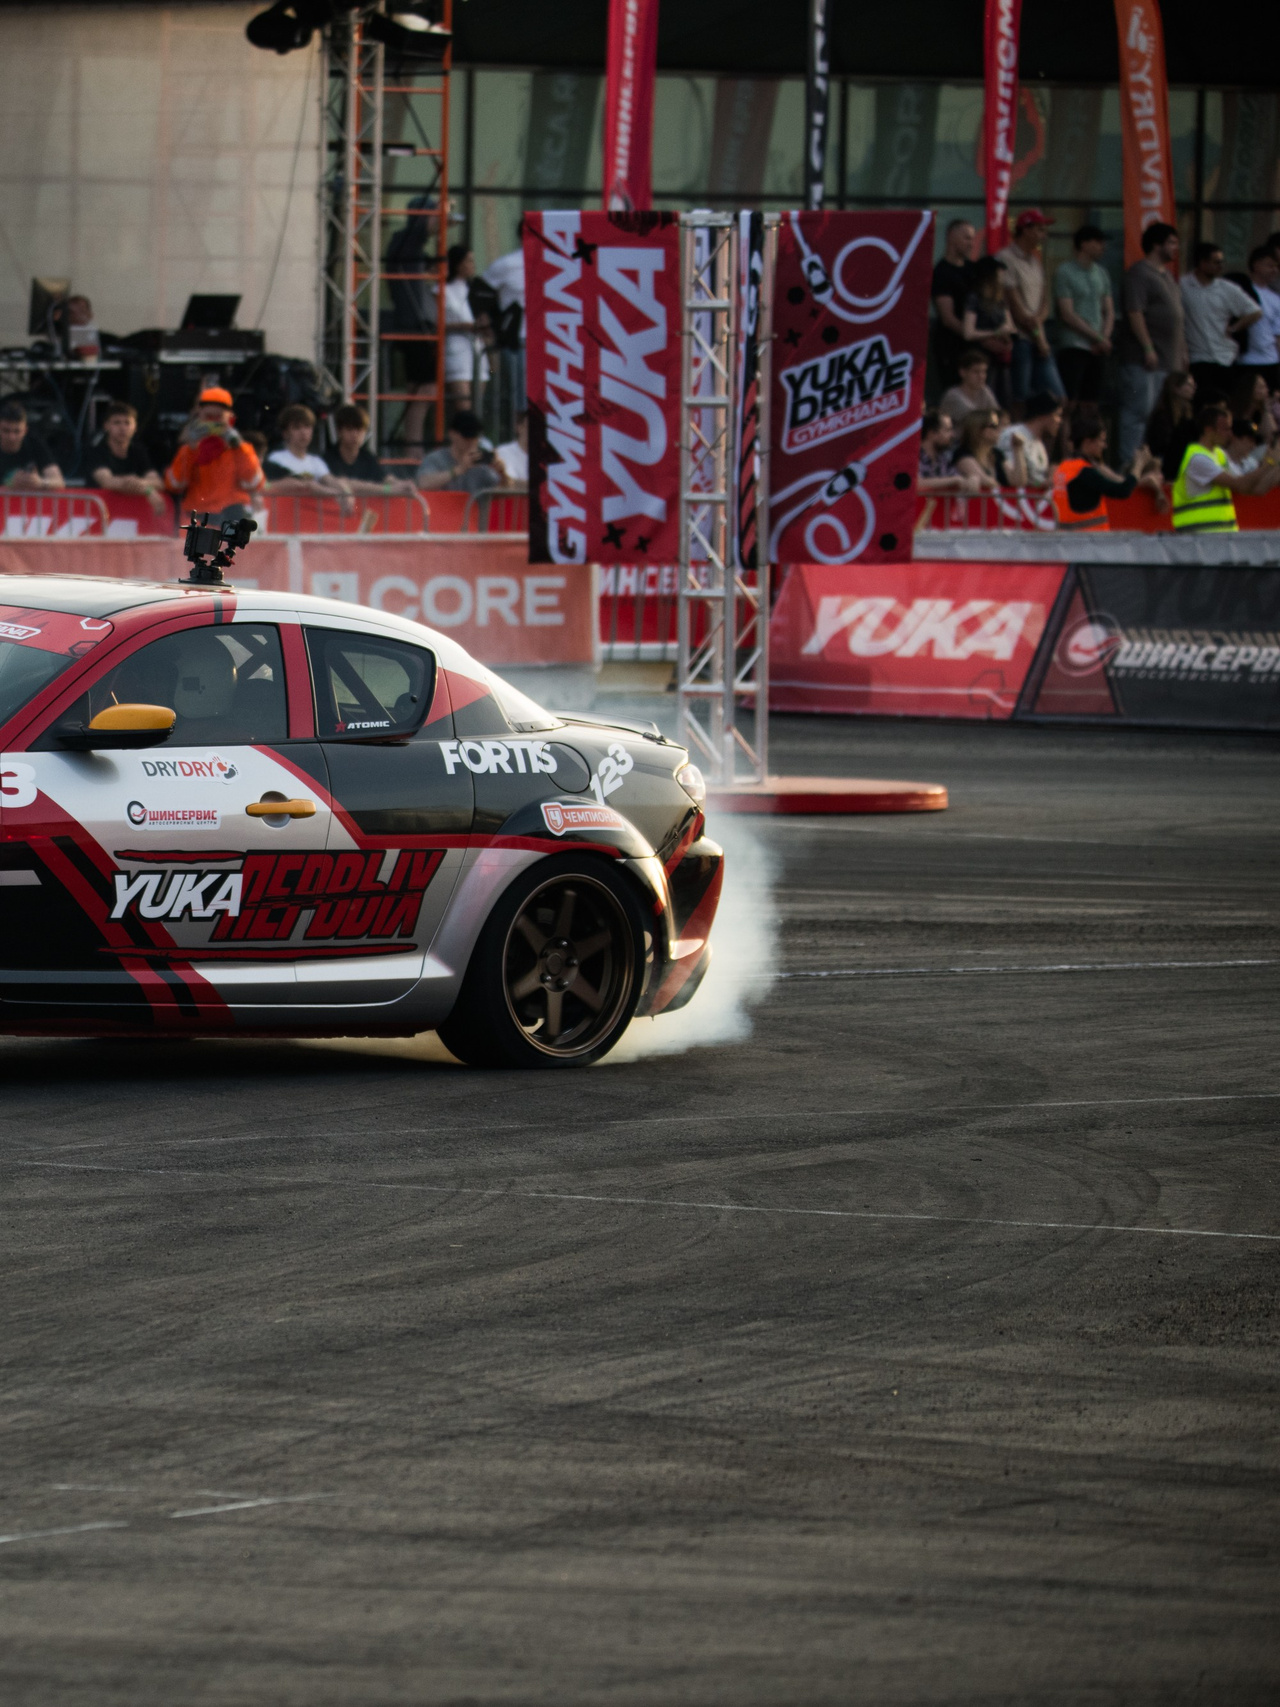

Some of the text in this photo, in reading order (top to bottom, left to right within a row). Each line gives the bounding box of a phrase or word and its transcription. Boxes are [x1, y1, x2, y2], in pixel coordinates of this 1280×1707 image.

[542, 211, 587, 565] GYMKHANA
[596, 246, 668, 523] YUKA
[785, 340, 889, 399] YUKA
[790, 359, 909, 428] DRIVE
[793, 394, 900, 443] GYMKHANA
[800, 596, 1032, 660] YUKA
[1113, 641, 1280, 673] ШИНСЕРВ
[347, 720, 391, 730] ATOMIC
[141, 760, 216, 777] DRYDRY
[438, 740, 558, 775] FORTIS
[588, 743, 634, 806] 123
[148, 809, 218, 821] ШИНСЕРВИС
[563, 811, 621, 823] ЧЕМПИОНА
[109, 873, 244, 919] YUKA
